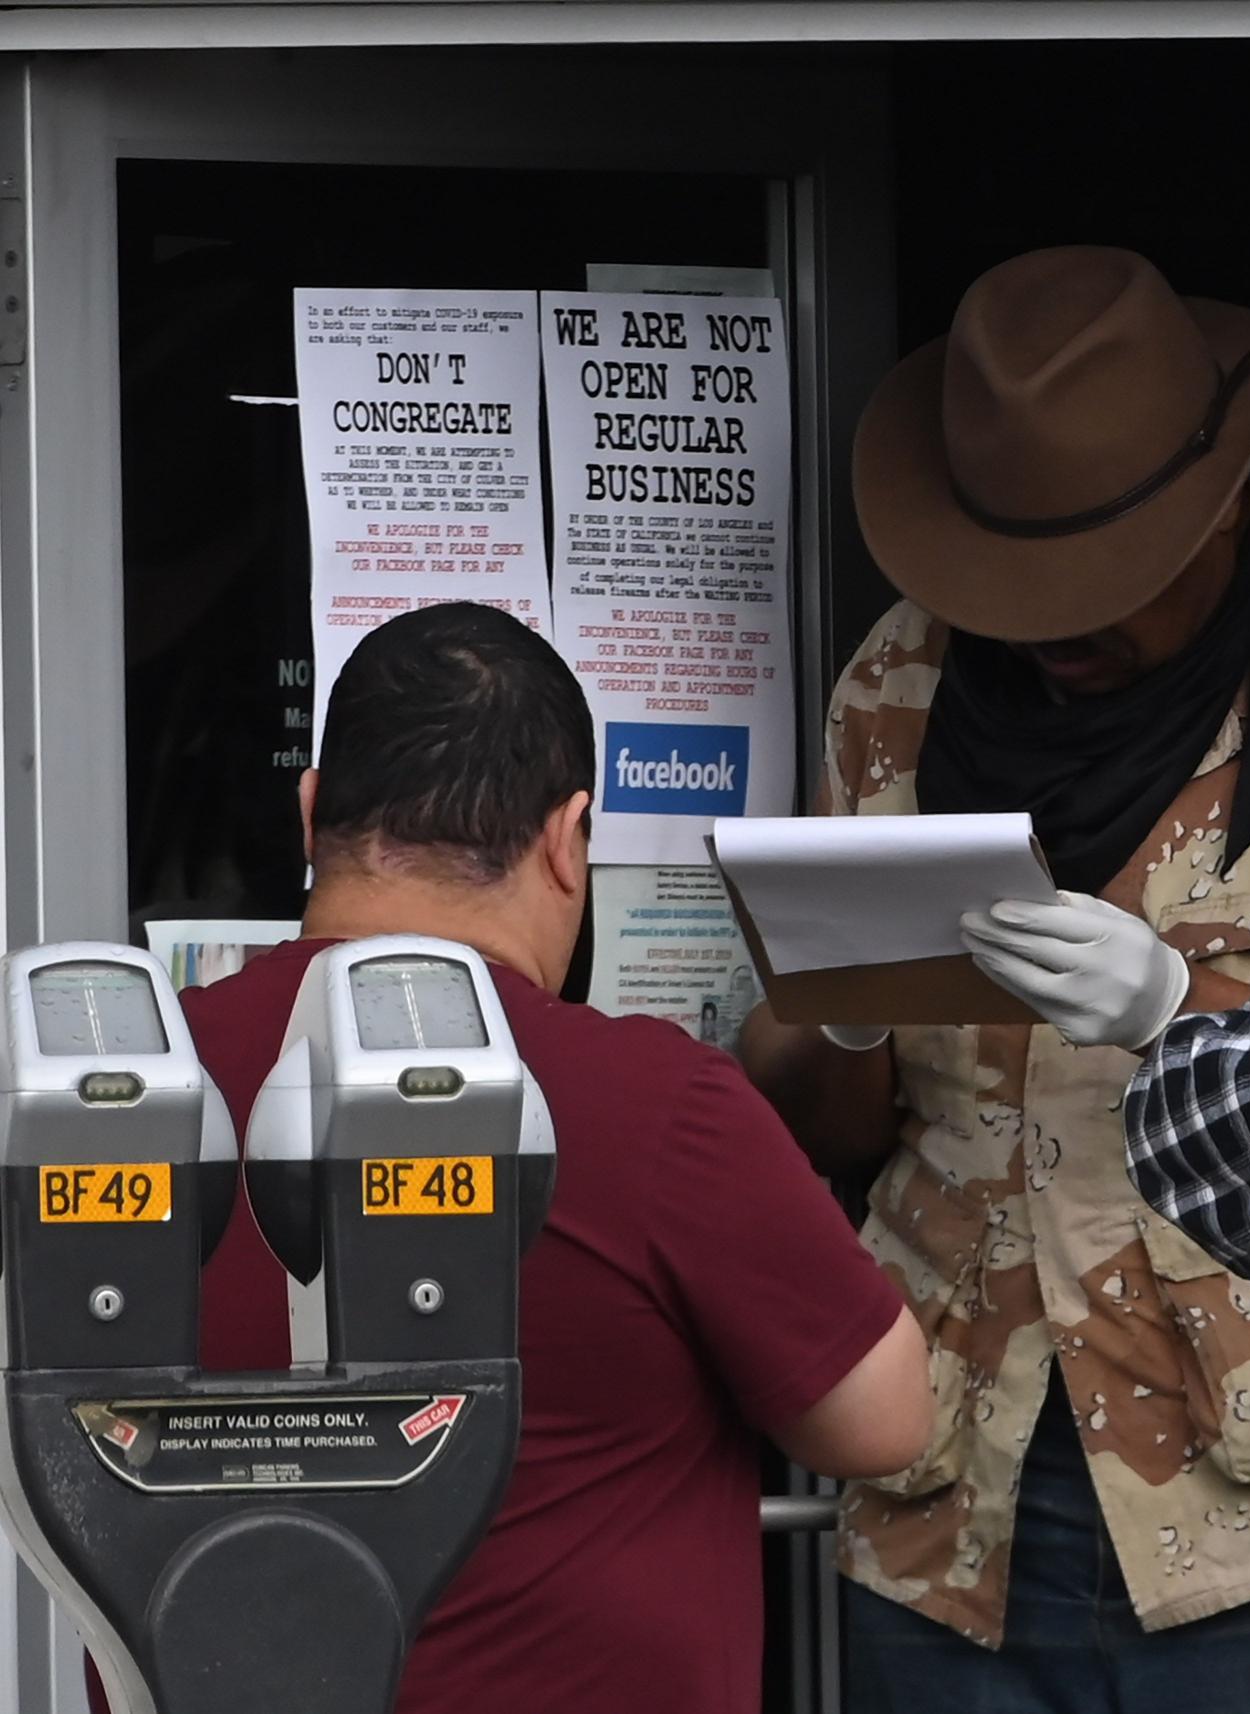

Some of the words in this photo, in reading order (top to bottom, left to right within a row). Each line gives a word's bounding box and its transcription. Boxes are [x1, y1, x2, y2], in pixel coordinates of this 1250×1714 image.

[553, 309, 599, 346] WE
[621, 311, 687, 349] ARE
[706, 315, 771, 353] NOT
[377, 353, 465, 384] DON'T
[581, 360, 668, 400] OPEN
[691, 365, 757, 403] FOR
[334, 401, 511, 434] CONGREGATE
[594, 413, 747, 454] REGULAR
[586, 464, 755, 507] BUSINESS
[616, 748, 734, 790] facebook
[43, 1168, 96, 1217] BF
[95, 1171, 155, 1220] 49
[367, 1163, 414, 1206] BF
[420, 1163, 475, 1205] 48
[169, 1416, 222, 1429] INSERT
[227, 1415, 270, 1428] VALID
[274, 1414, 320, 1428] COINS
[325, 1414, 368, 1426] ONLY.
[409, 1415, 432, 1435] THIS
[430, 1404, 450, 1421] CAR
[161, 1439, 208, 1450] DISPLAY
[212, 1437, 271, 1448] INDICATES
[275, 1437, 300, 1447] TIME
[304, 1436, 377, 1447] PURCHASED.
